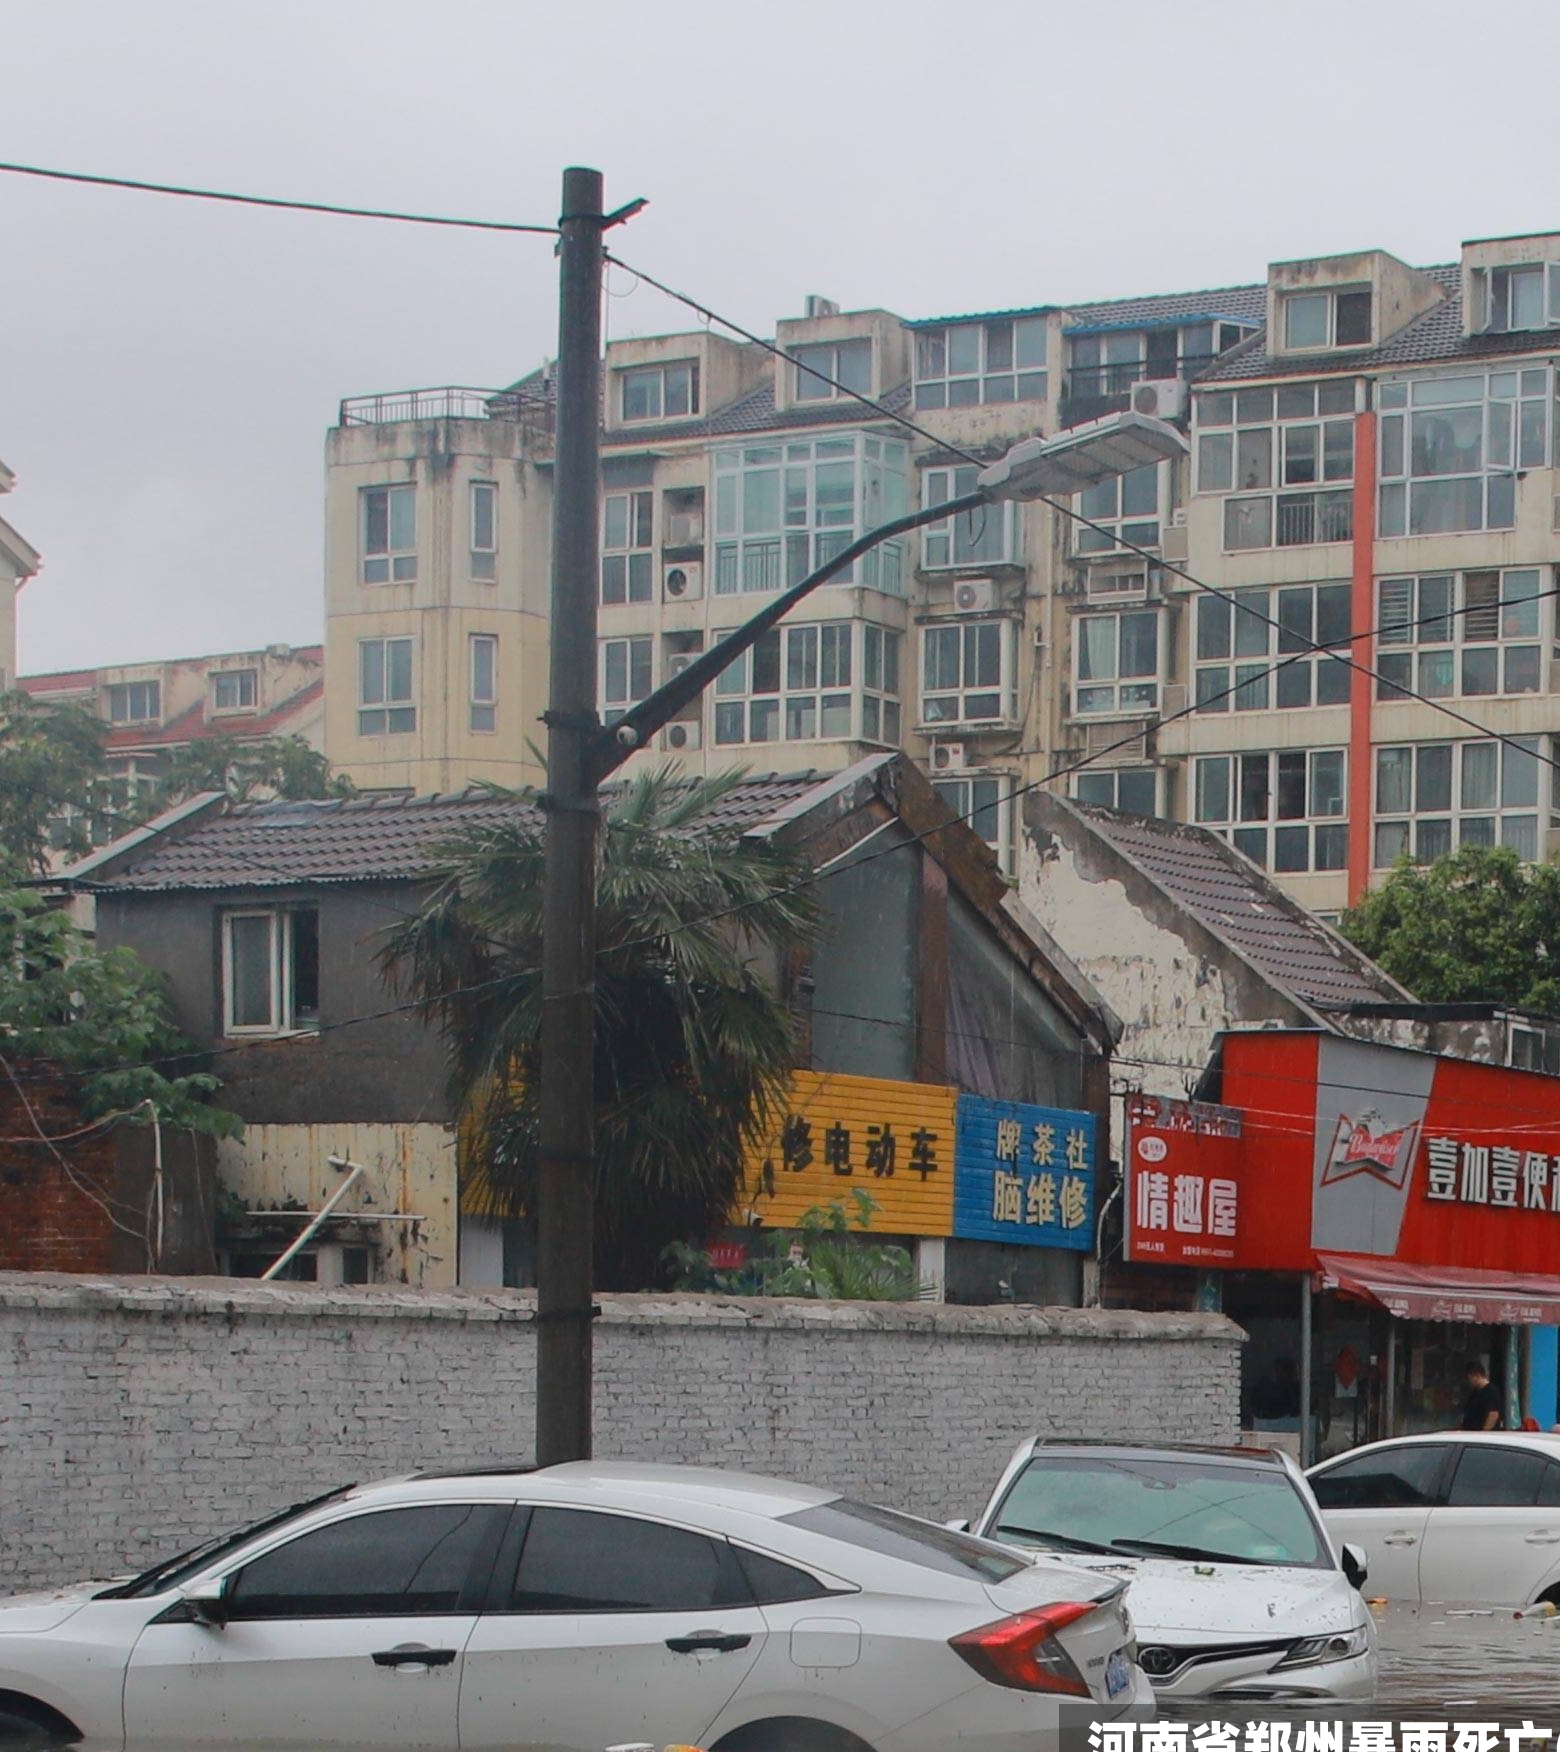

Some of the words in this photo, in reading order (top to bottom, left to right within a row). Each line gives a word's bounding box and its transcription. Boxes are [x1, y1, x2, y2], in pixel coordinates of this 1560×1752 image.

[780, 1113, 939, 1182] 修电动车
[994, 1119, 1089, 1171] 牌茶社
[992, 1169, 1089, 1230] 脑维修
[1136, 1170, 1238, 1237] 情趣屋
